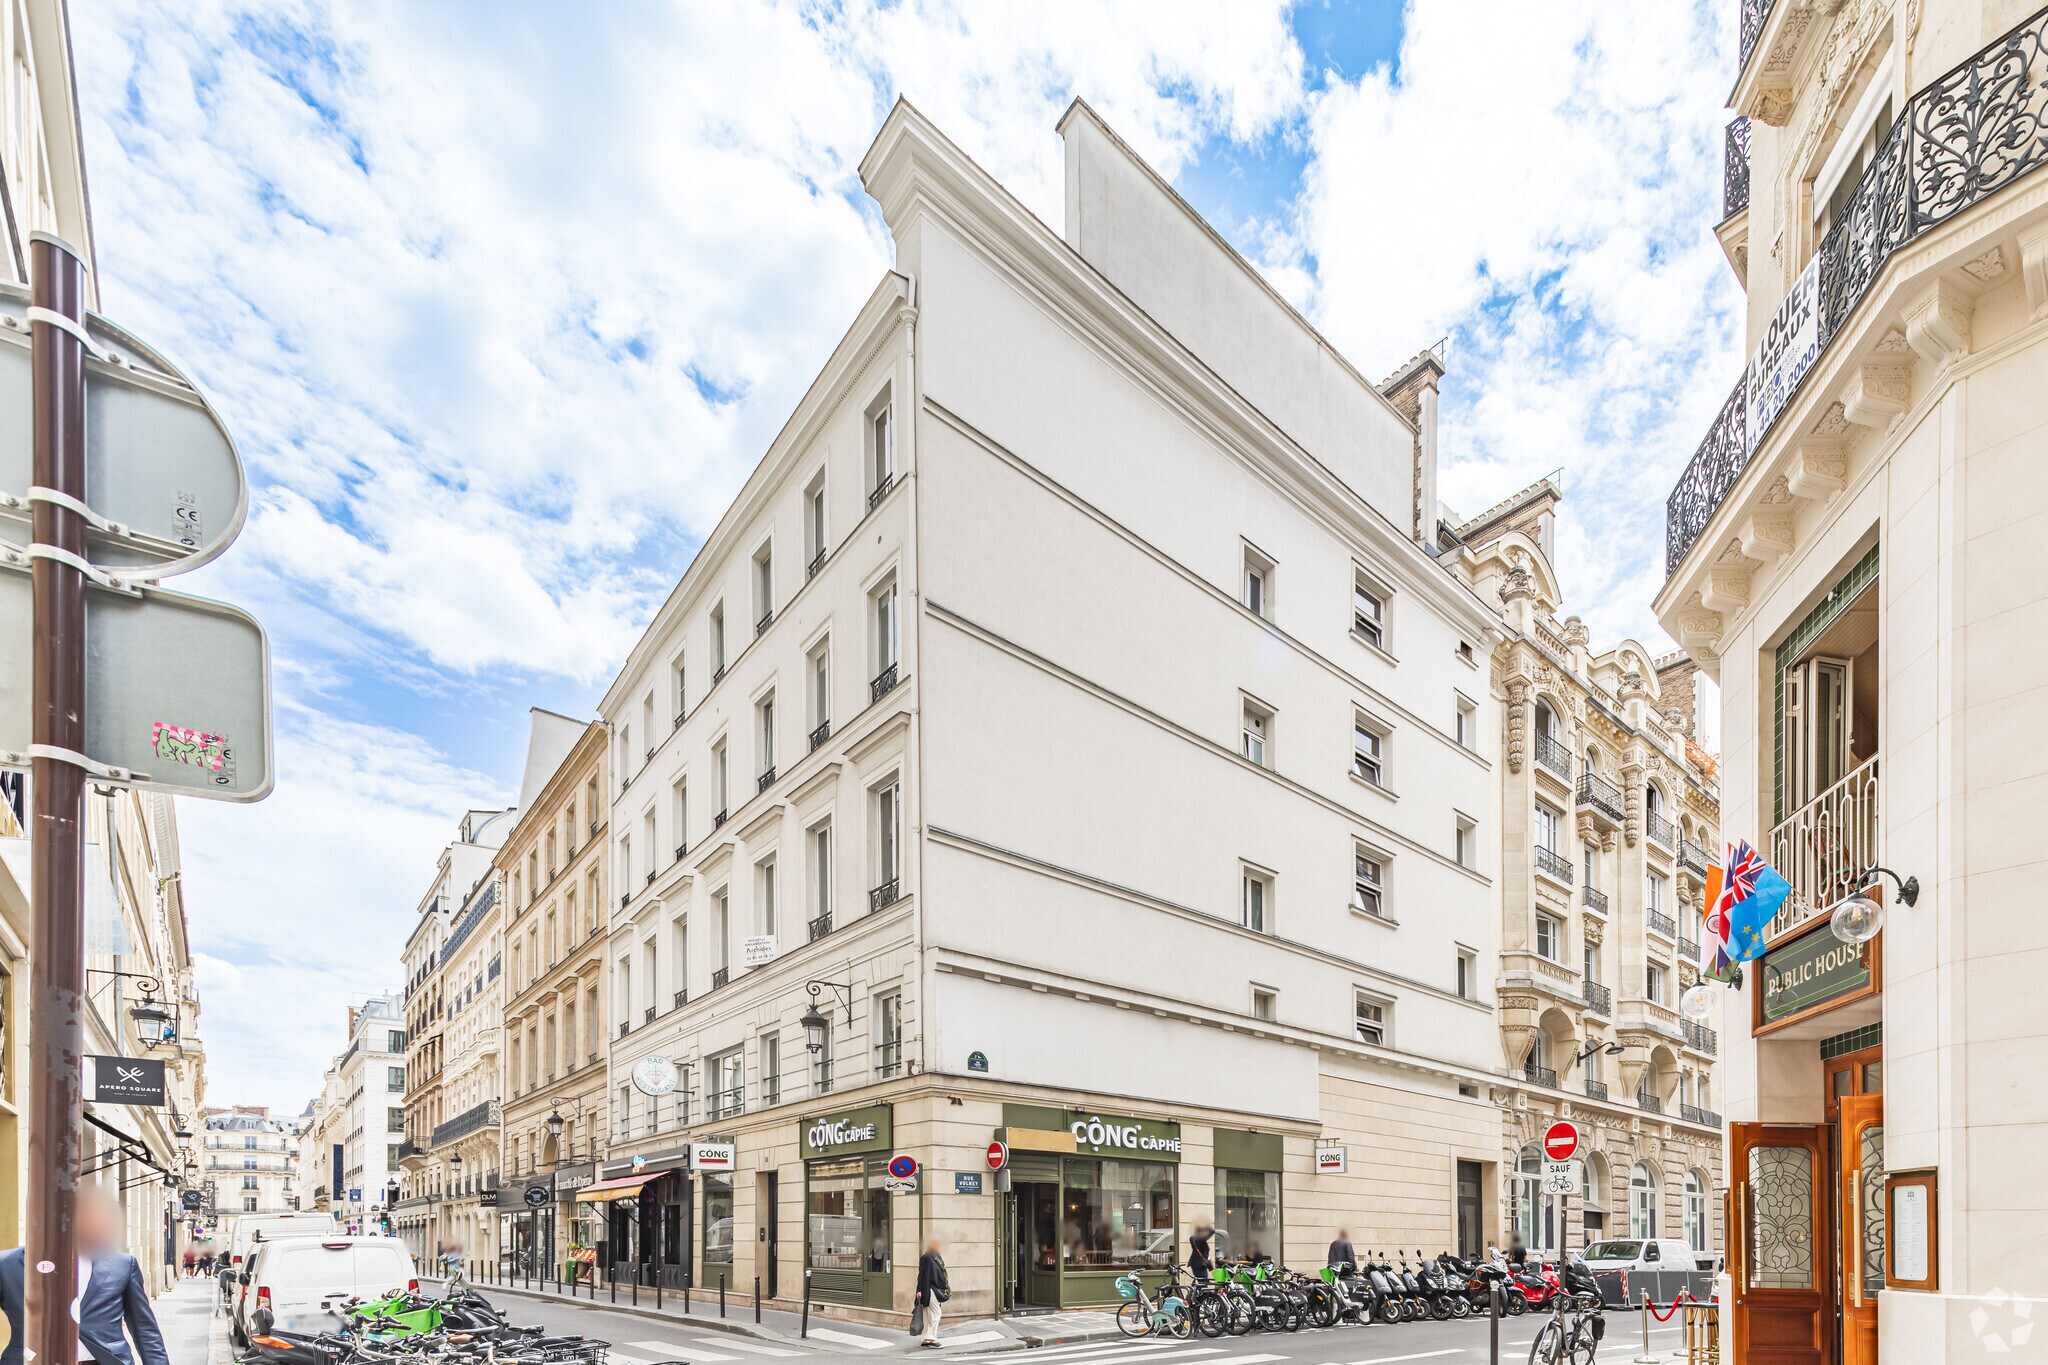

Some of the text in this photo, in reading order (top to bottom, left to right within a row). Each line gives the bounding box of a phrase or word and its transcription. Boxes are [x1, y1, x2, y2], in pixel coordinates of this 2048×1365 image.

[1761, 262, 1816, 366] LOUER
[1751, 298, 1811, 406] BUREAUX
[1747, 430, 1757, 453] 01
[1760, 407, 1770, 432] 44
[1773, 386, 1785, 413] 20
[1788, 343, 1816, 392] 2000
[1768, 941, 1864, 998] PUBLIC HOUSE
[636, 1075, 676, 1094] RESTAURANT
[647, 1057, 664, 1065] BAR
[1550, 1164, 1571, 1173] SAUF
